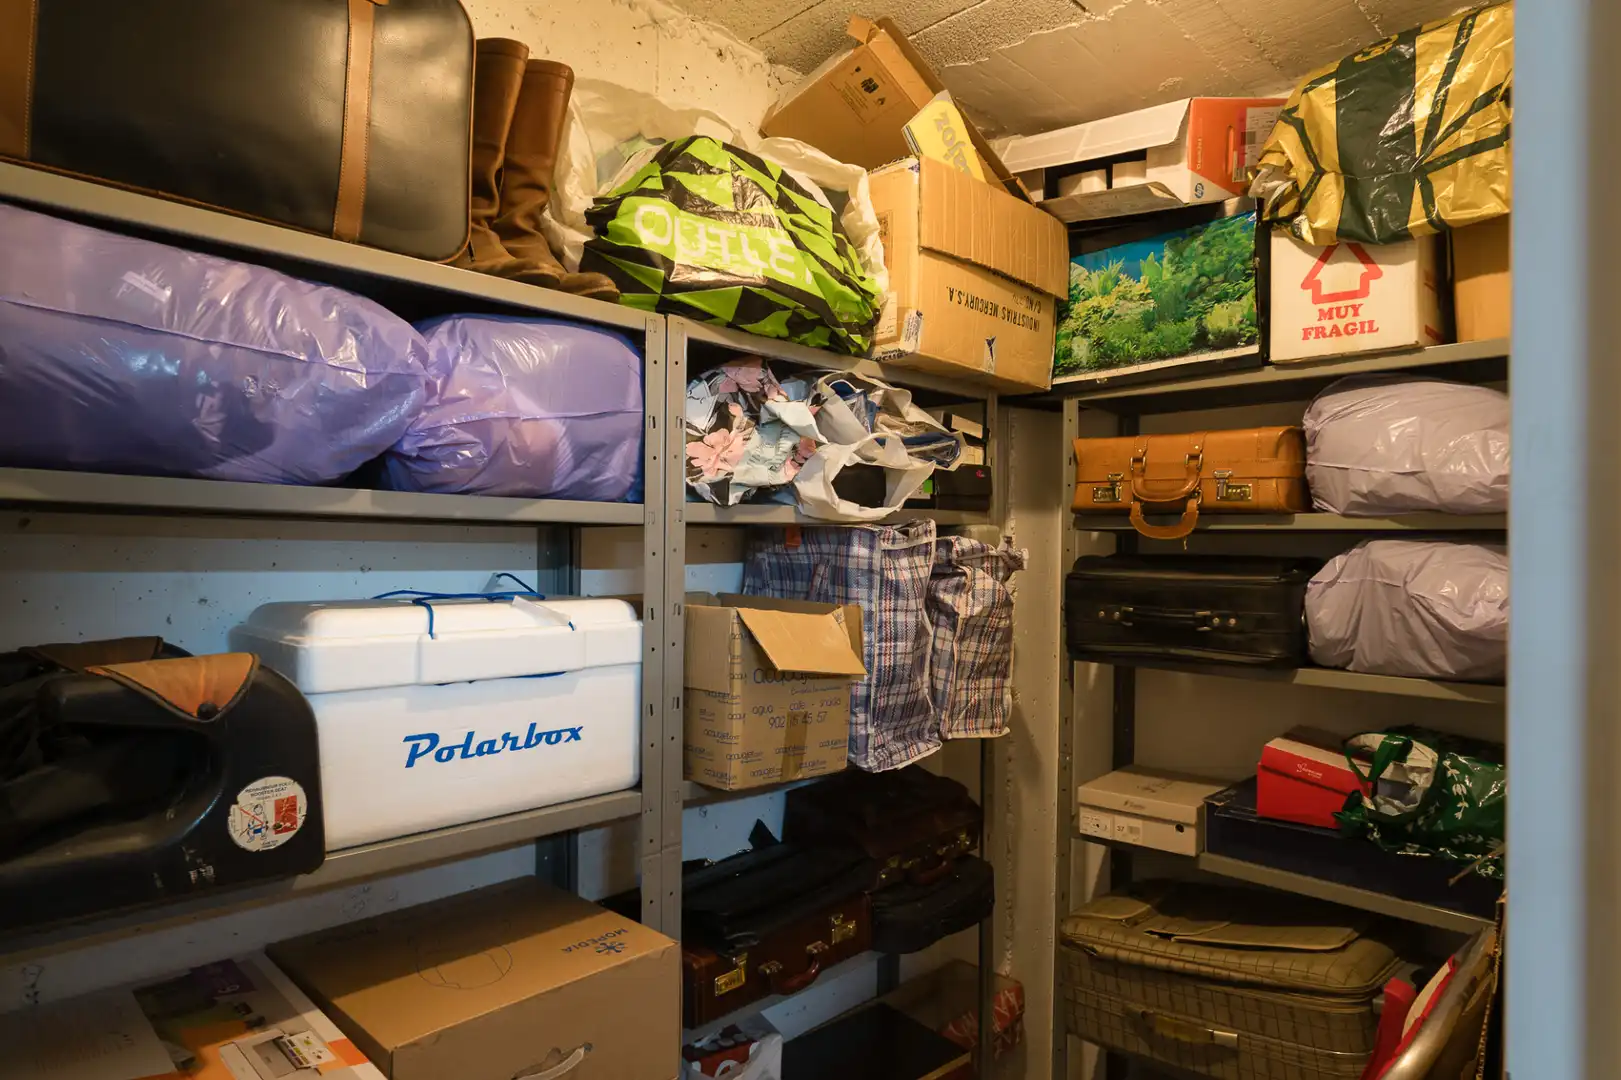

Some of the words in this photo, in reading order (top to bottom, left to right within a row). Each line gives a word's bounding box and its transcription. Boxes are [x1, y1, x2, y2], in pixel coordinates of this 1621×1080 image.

[932, 111, 971, 176] ajoz
[634, 204, 813, 285] OUTLE
[1001, 305, 1040, 332] INDUSTRIAS
[1317, 303, 1364, 321] MUY
[1301, 319, 1379, 341] FRAGIL
[768, 715, 786, 729] 902
[816, 710, 828, 724] 57
[402, 722, 584, 769] Polarbox
[561, 927, 629, 954] MOPEDIA
